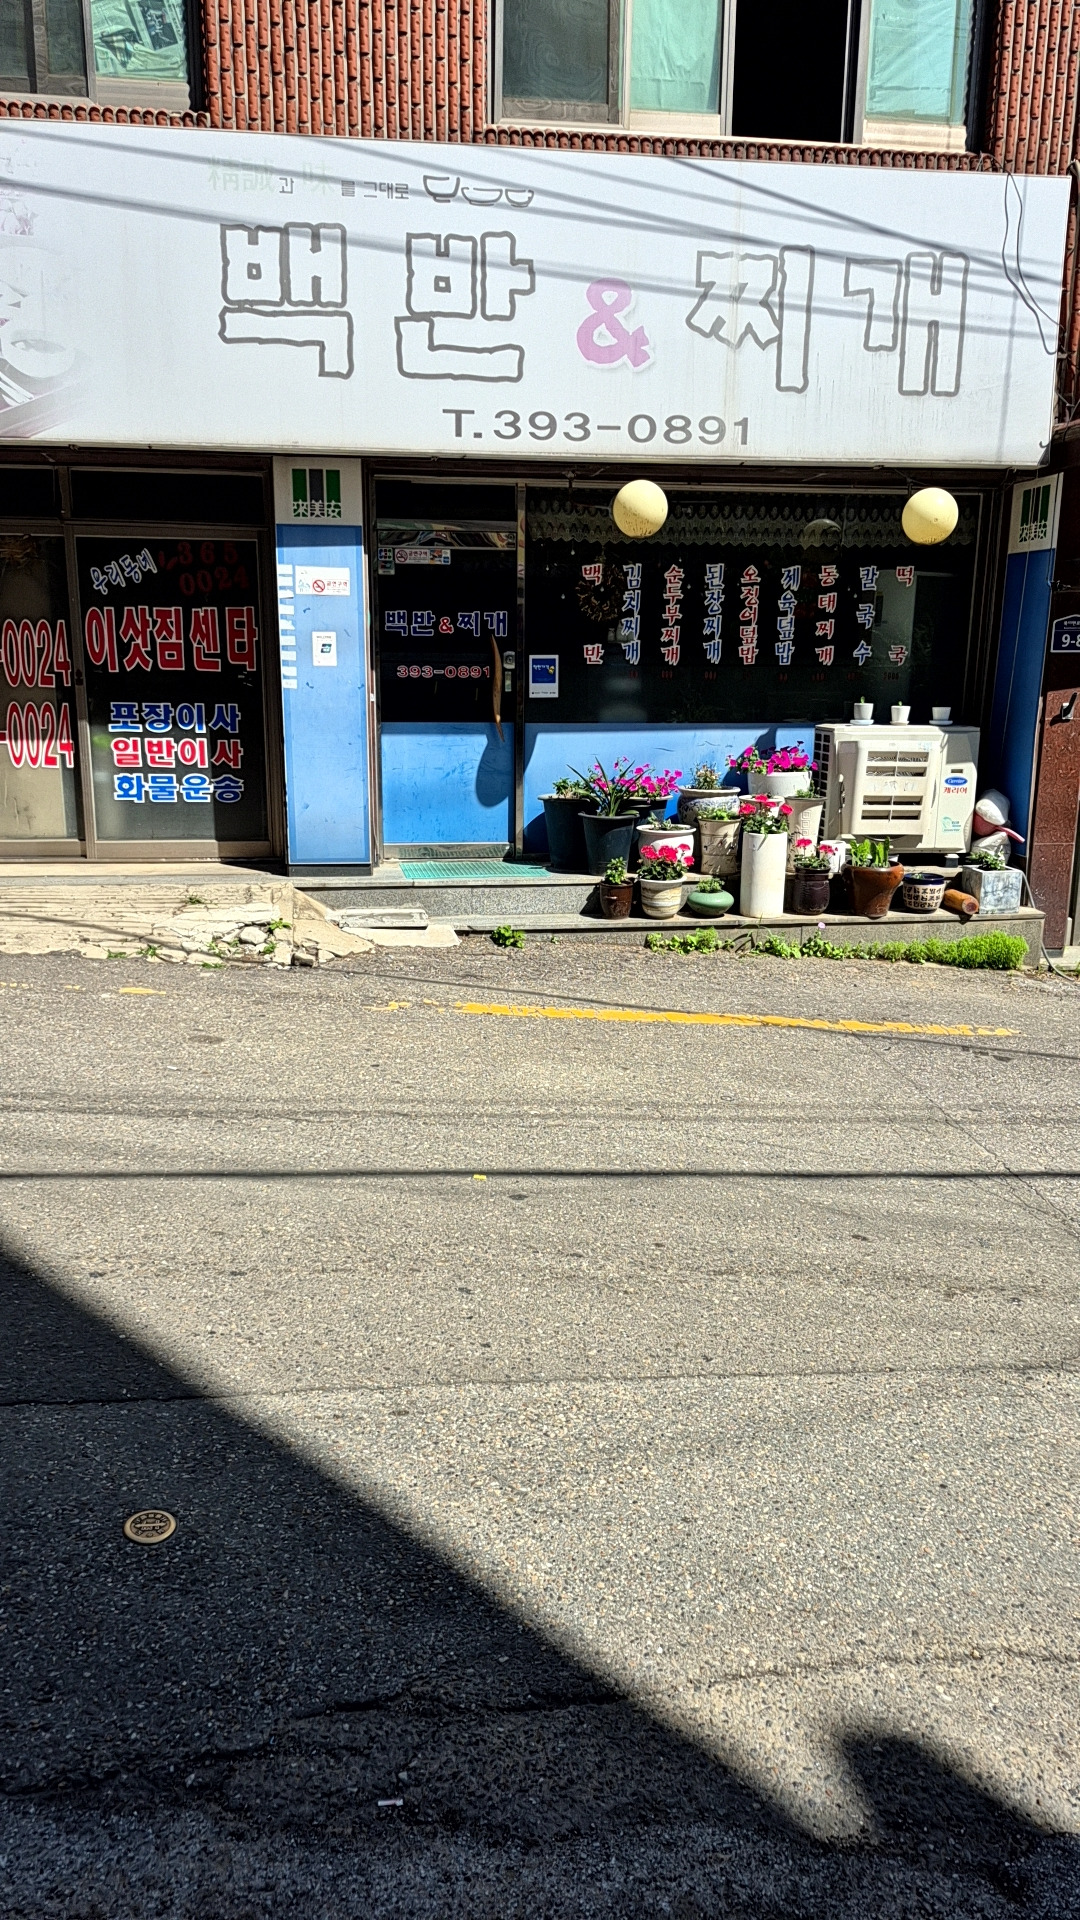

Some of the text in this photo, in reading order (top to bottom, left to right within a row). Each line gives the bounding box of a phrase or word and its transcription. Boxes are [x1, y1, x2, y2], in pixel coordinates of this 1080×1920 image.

[363, 181, 411, 200] 그대로
[217, 222, 970, 397] 백반 & 찌개
[442, 408, 749, 446] T.393-0891
[90, 547, 158, 596] 우리동네
[84, 606, 258, 673] 이삿짐센타
[621, 563, 642, 665] 김치찌개
[660, 564, 685, 666] 순두부찌개
[702, 563, 725, 665] 된장찌개
[738, 564, 761, 665] 오징어덮밥
[775, 565, 801, 666] 제육덮밥
[815, 565, 839, 666] 동태찌개
[853, 566, 879, 666] 칼국수
[396, 665, 490, 678] 393-0891
[108, 701, 241, 734] 포장이사
[110, 737, 244, 769] 일반이사
[113, 773, 245, 804] 화물운송
